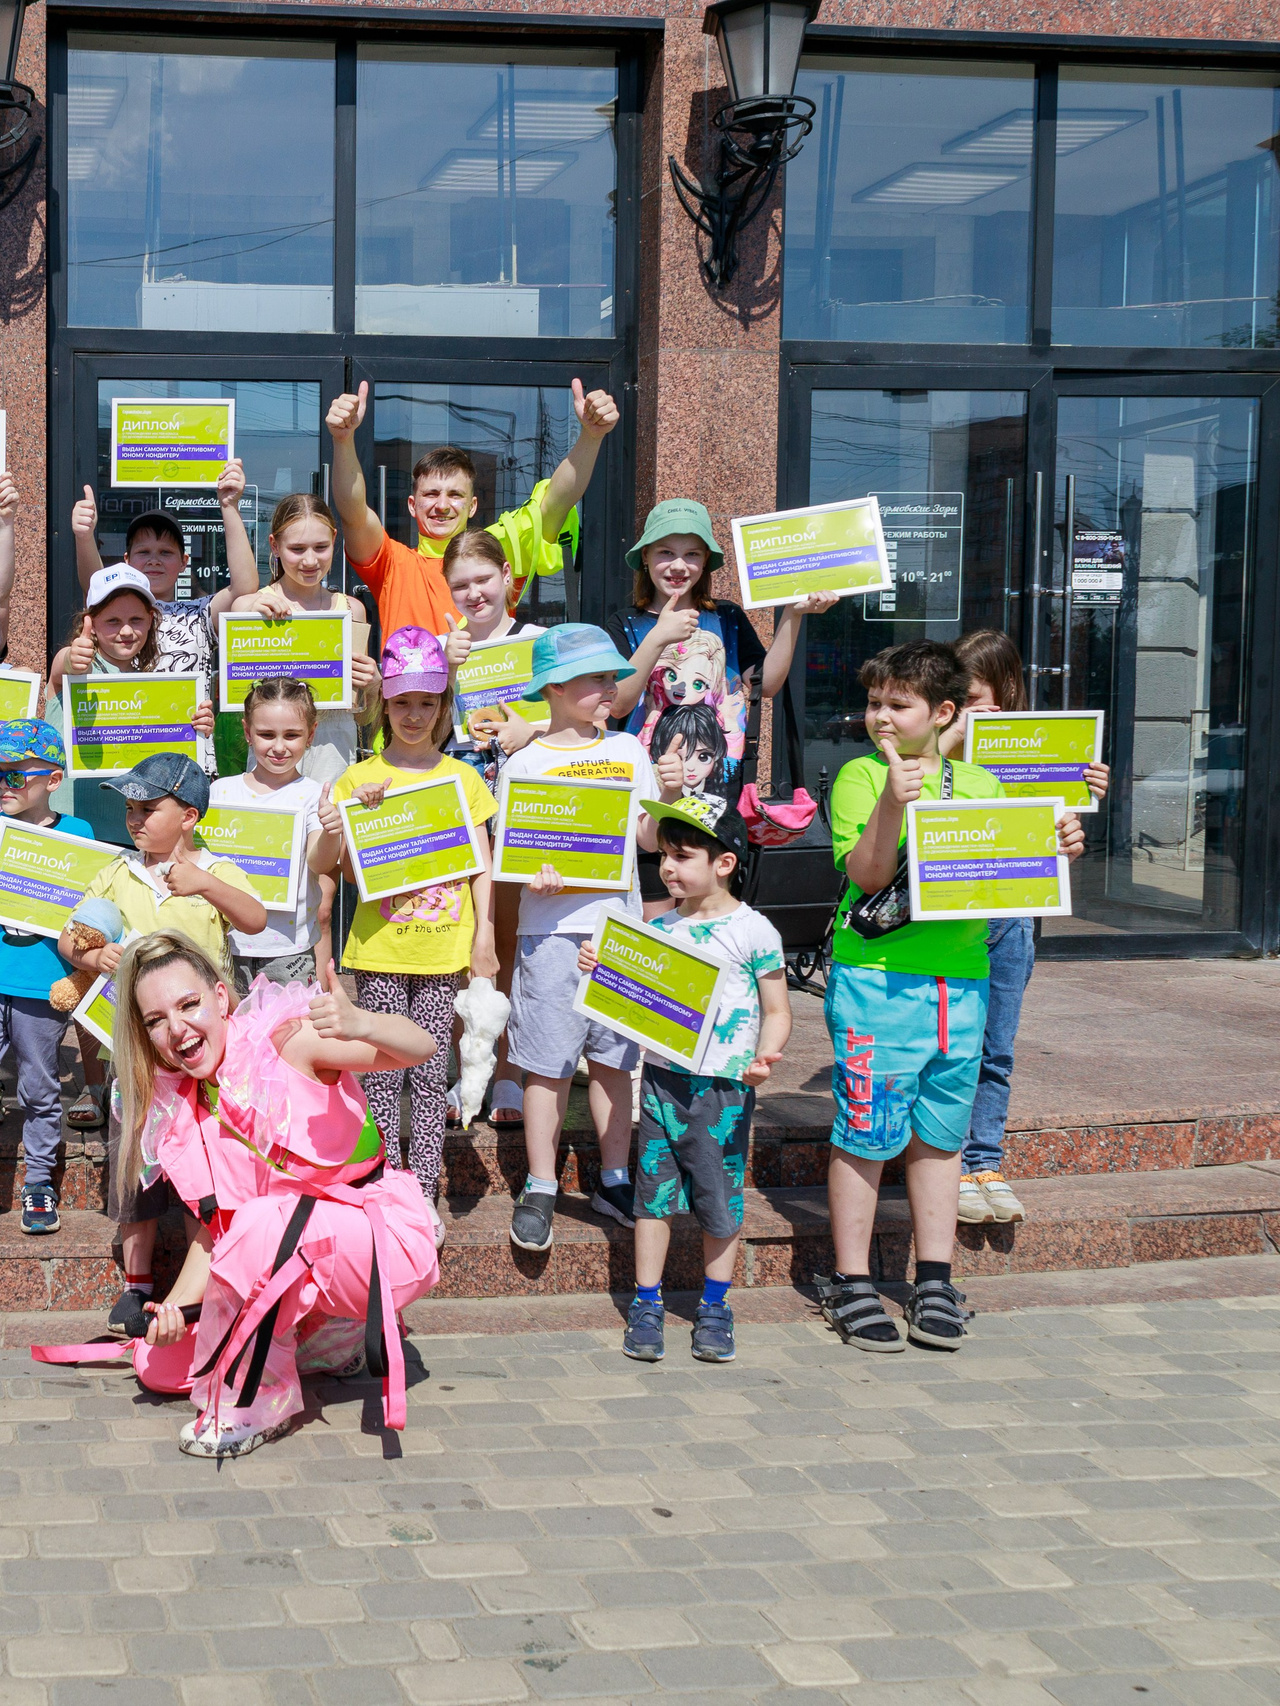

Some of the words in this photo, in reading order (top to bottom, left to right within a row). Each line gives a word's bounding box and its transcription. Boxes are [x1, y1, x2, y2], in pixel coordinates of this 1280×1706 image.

[122, 420, 180, 432] ДИПЛОМ
[165, 496, 220, 510] Сормовски
[878, 504, 930, 517] ормовские
[932, 504, 958, 517] Зори
[749, 530, 816, 552] ДИПЛОМ
[752, 563, 777, 571] ВЫДАН
[777, 558, 807, 567] САМОМУ
[808, 550, 862, 562] ТАЛАНТЛИВОМУ
[753, 568, 780, 577] ЮНОМУ
[780, 562, 821, 572] КОНДИТЕРУ
[231, 636, 293, 650] ДИПЛОМ
[77, 698, 142, 714] ДИПЛОМ
[570, 759, 611, 768] FUTURE
[558, 767, 625, 777] GENERATION
[511, 801, 577, 816] ДИПЛОМ
[355, 811, 414, 836] ДИПЛОМ
[562, 835, 613, 844] ТАЛАНТЛИВОМУ
[923, 828, 995, 846] ДИПЛОМ
[361, 849, 384, 859] ВЫДАН
[384, 842, 409, 853] САМОМУ
[410, 831, 456, 847] ТАЛАНТЛИВОМУ
[4, 846, 71, 872] ДИПЛОМ
[363, 855, 387, 865] ЮНОМУ
[387, 846, 422, 859] КОНДИТЕРУ
[397, 925, 410, 934] of
[415, 924, 432, 933] the
[286, 956, 302, 970] Where
[603, 938, 664, 974] ДИПЛОМ
[290, 970, 298, 978] are
[595, 973, 618, 988] ЮНОМУ
[618, 985, 653, 1006] КОНДИТЕРУ
[597, 967, 618, 981] ВЫДАН
[618, 978, 644, 994] САМОМУ
[644, 990, 693, 1018] ТАЛАНТЛИВОМУ
[846, 1027, 874, 1131] HEAT
